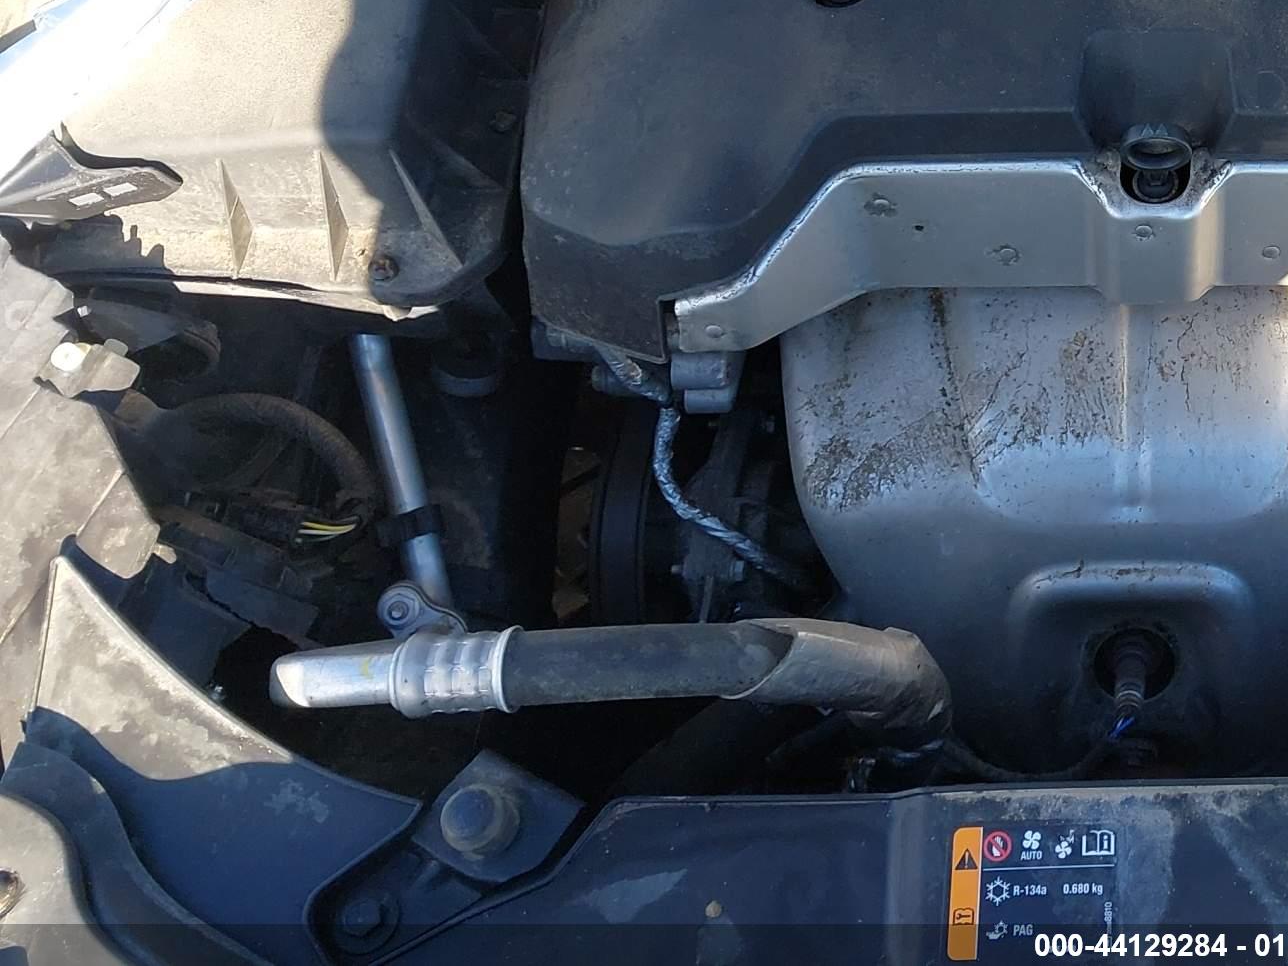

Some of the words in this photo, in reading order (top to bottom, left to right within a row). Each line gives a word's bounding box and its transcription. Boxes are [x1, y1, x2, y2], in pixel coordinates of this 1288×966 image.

[1020, 850, 1043, 861] AUTO
[1013, 884, 1047, 897] R-134a
[1063, 883, 1090, 895] 0.680
[1092, 882, 1103, 895] kg
[1012, 923, 1034, 936] PAG
